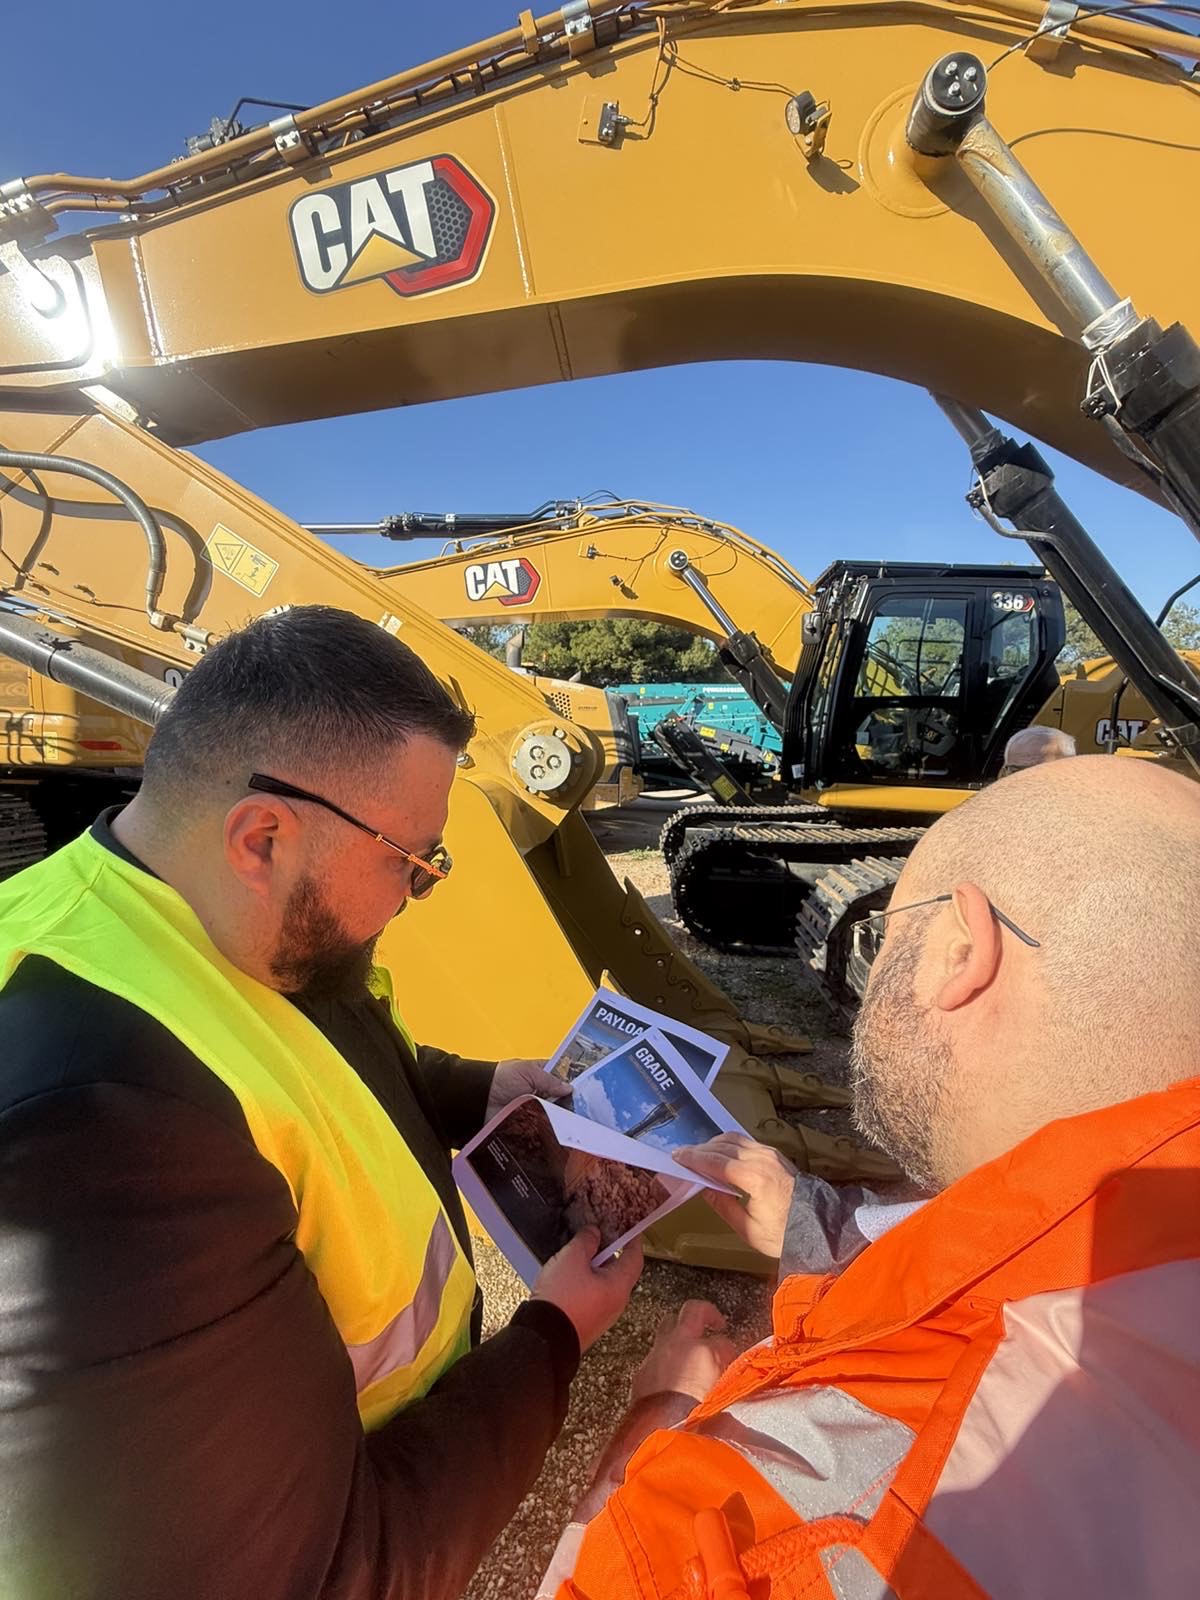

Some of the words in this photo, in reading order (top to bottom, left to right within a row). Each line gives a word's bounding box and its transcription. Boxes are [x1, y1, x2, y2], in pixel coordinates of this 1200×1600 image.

[292, 161, 437, 290] CAT
[465, 559, 520, 600] CAT
[992, 592, 1024, 610] 336
[635, 1047, 674, 1090] GRADE
